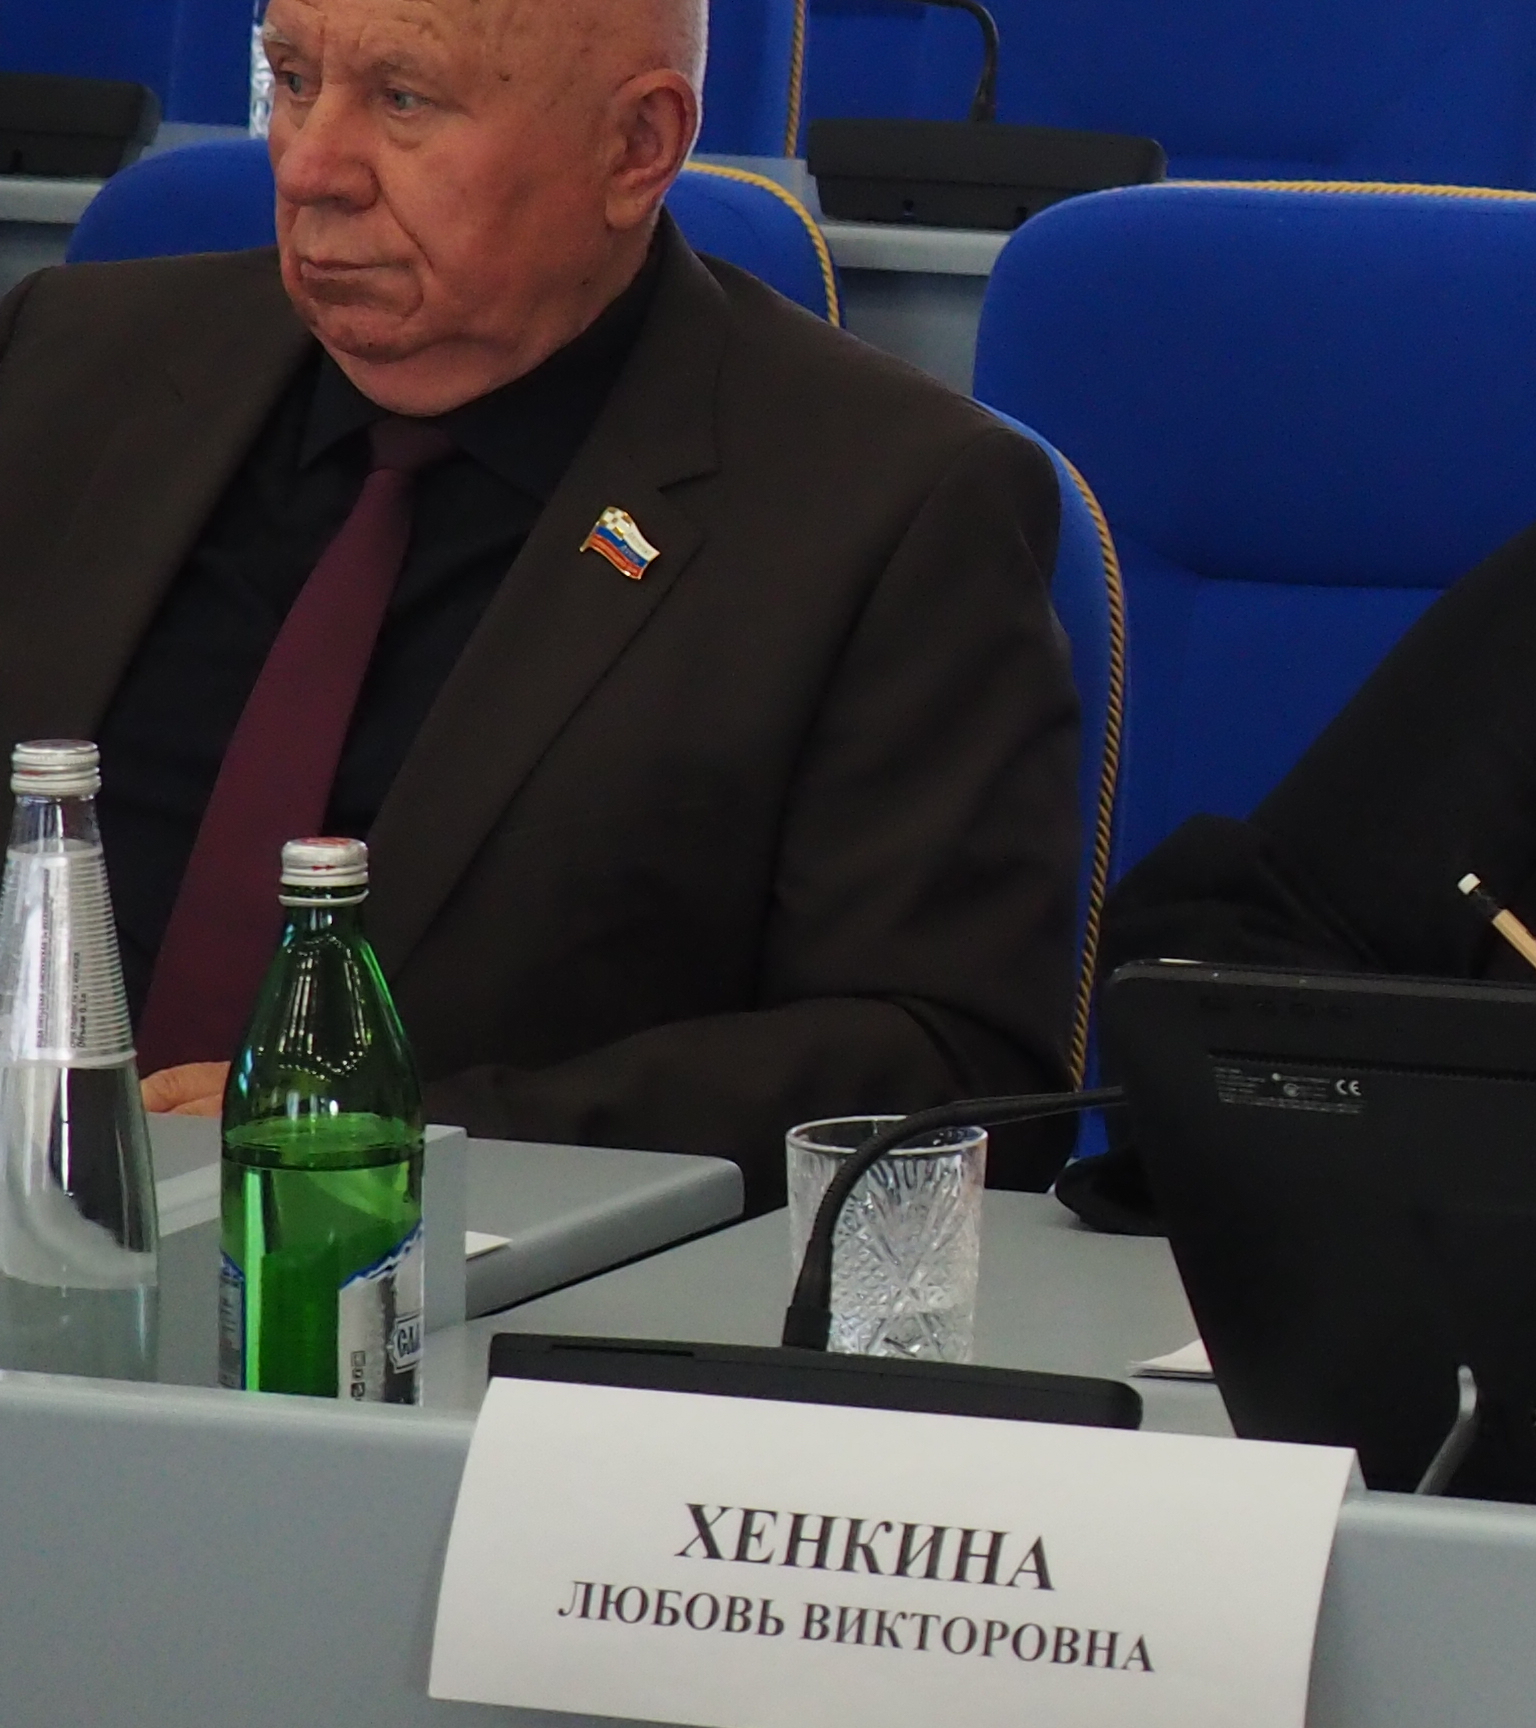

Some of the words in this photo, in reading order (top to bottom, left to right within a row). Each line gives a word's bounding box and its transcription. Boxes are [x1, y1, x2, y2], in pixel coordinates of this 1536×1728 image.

[675, 1502, 1055, 1592] ХЕНКИНА
[557, 1580, 786, 1638] ЛЮБОВЬ
[801, 1602, 1154, 1673] ВИКТОРОВНА
